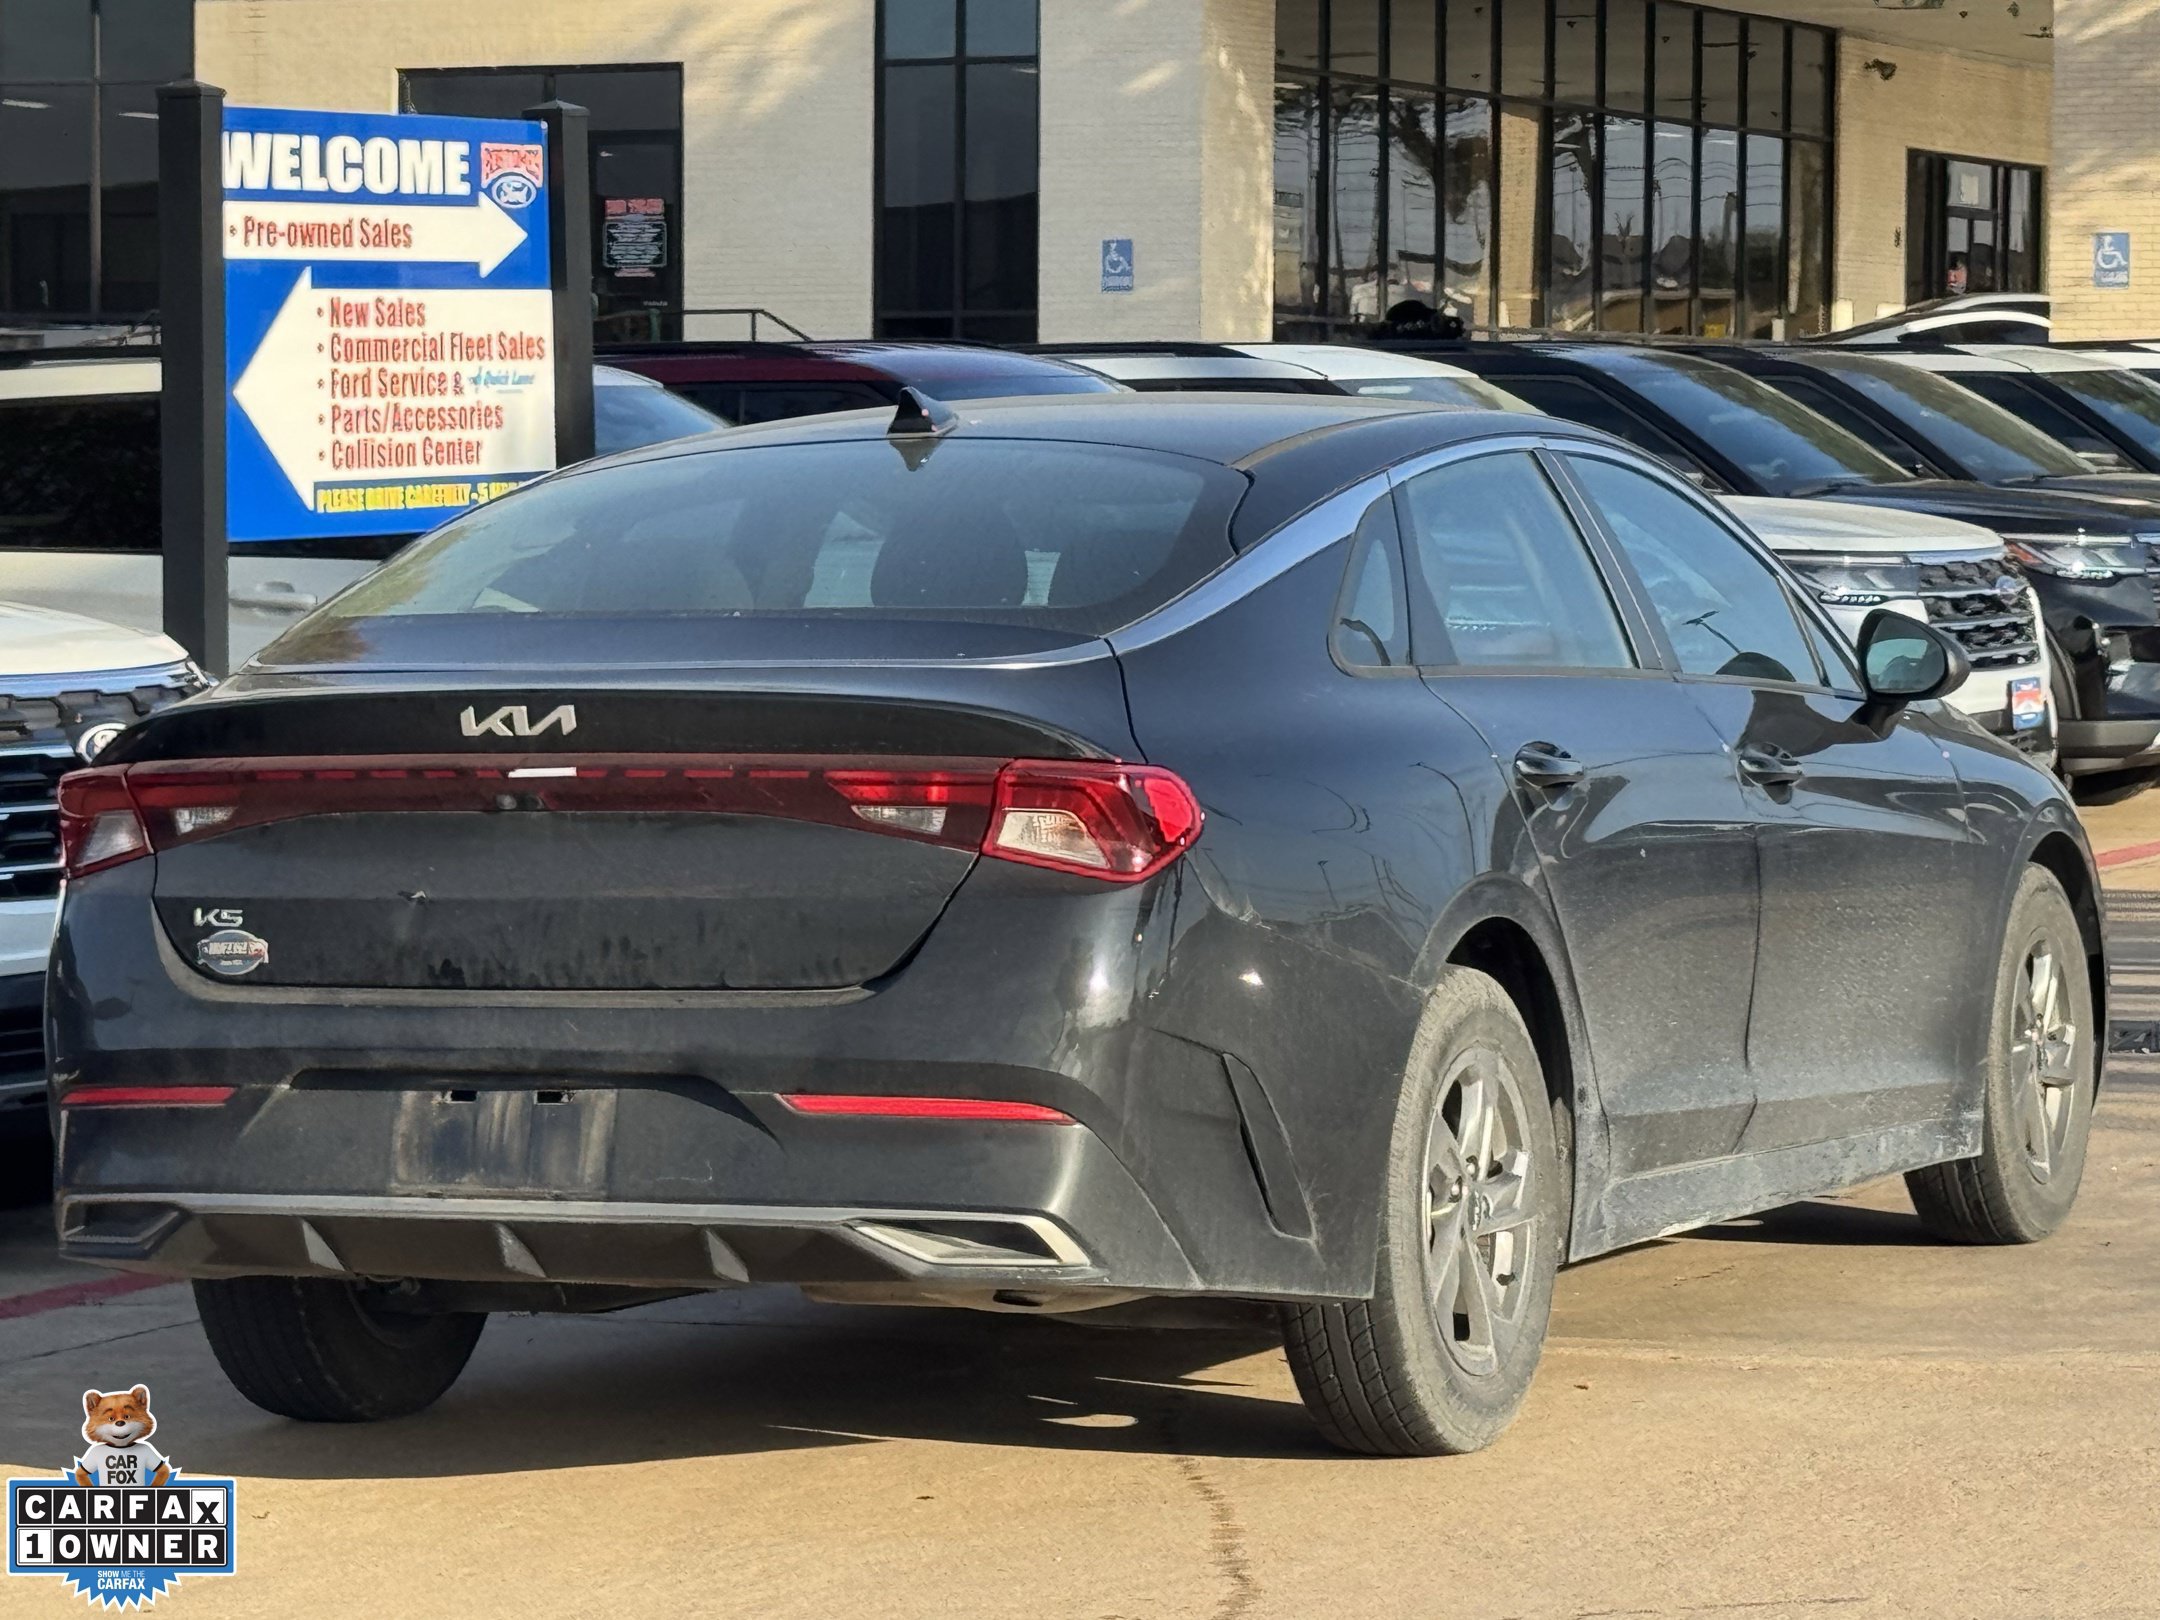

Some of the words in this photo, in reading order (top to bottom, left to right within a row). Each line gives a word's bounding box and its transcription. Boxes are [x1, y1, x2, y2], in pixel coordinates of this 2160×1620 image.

[223, 131, 471, 195] WELCOME
[243, 216, 354, 248] Pre-owned
[360, 217, 413, 249] Sales
[329, 297, 369, 328] New
[375, 298, 426, 328] Sales
[330, 332, 445, 363] Commercial
[450, 333, 493, 362] Fleet
[498, 332, 546, 360] Sales
[330, 368, 372, 399] Ford
[378, 367, 449, 398] Service
[452, 371, 465, 396] &
[331, 401, 504, 434] Parts/Accessories
[331, 440, 417, 470] Collision
[422, 438, 483, 466] Center
[460, 705, 577, 736] KIA
[193, 907, 244, 927] K5
